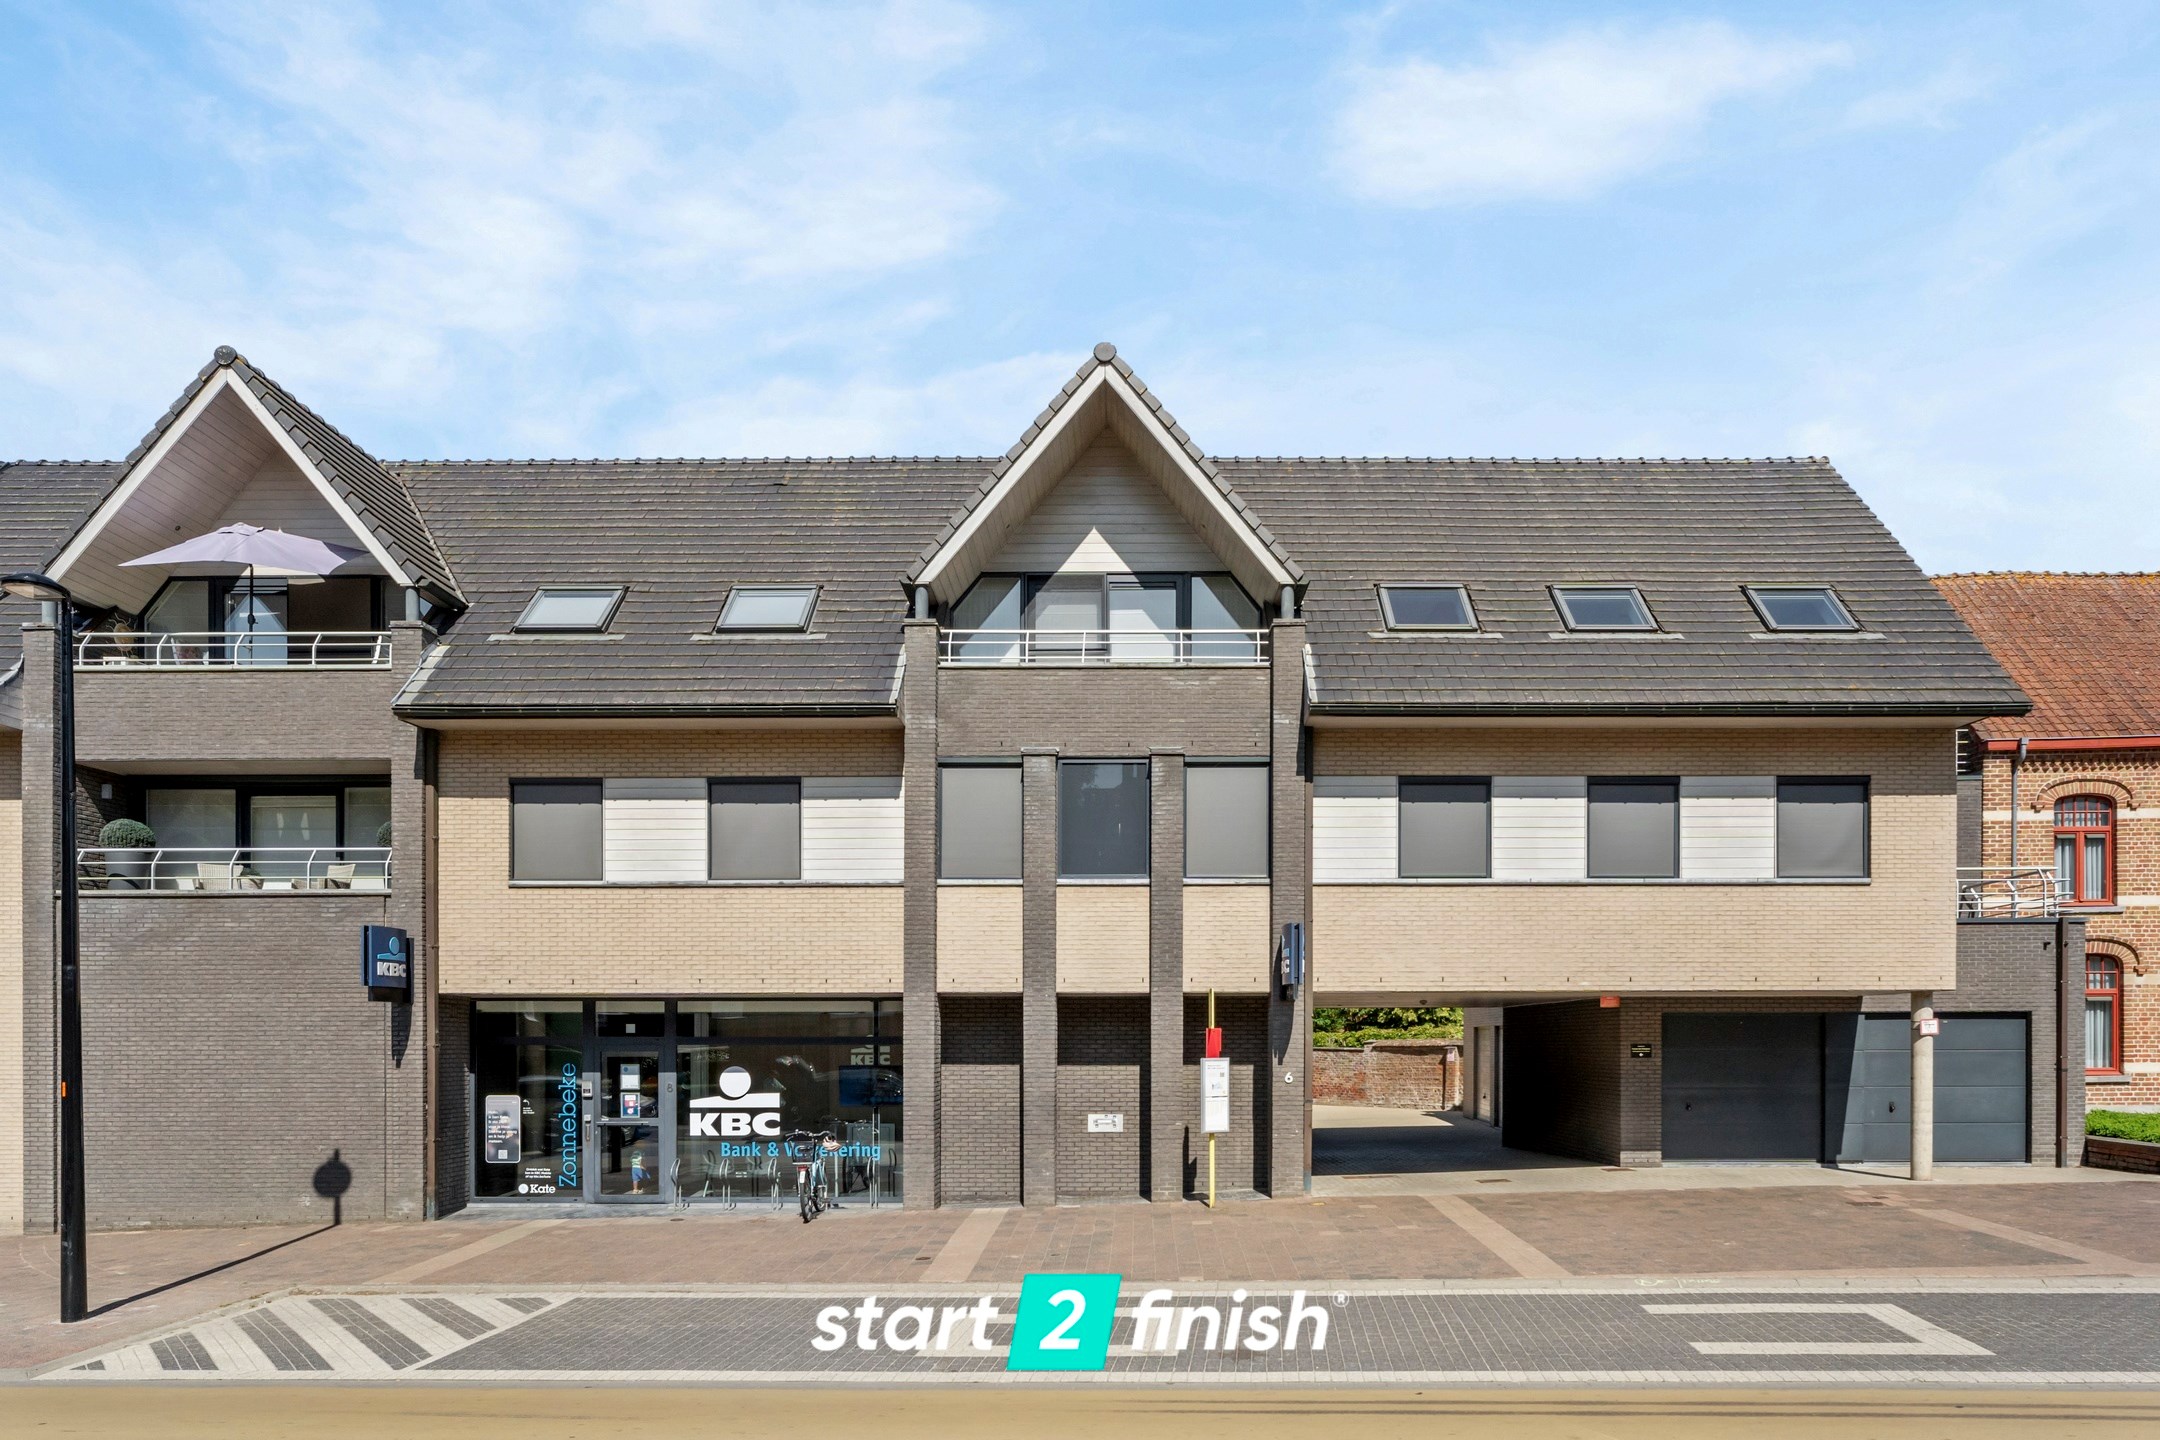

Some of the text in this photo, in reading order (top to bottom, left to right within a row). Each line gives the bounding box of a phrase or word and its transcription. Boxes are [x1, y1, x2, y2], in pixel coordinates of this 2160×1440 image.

[377, 961, 406, 977] KBC
[1285, 1071, 1294, 1083] 6
[558, 1063, 577, 1187] Zonnebeke
[689, 1112, 781, 1137] KBC
[721, 1142, 761, 1157] Bank
[767, 1142, 779, 1157] &
[529, 1184, 556, 1194] Kate
